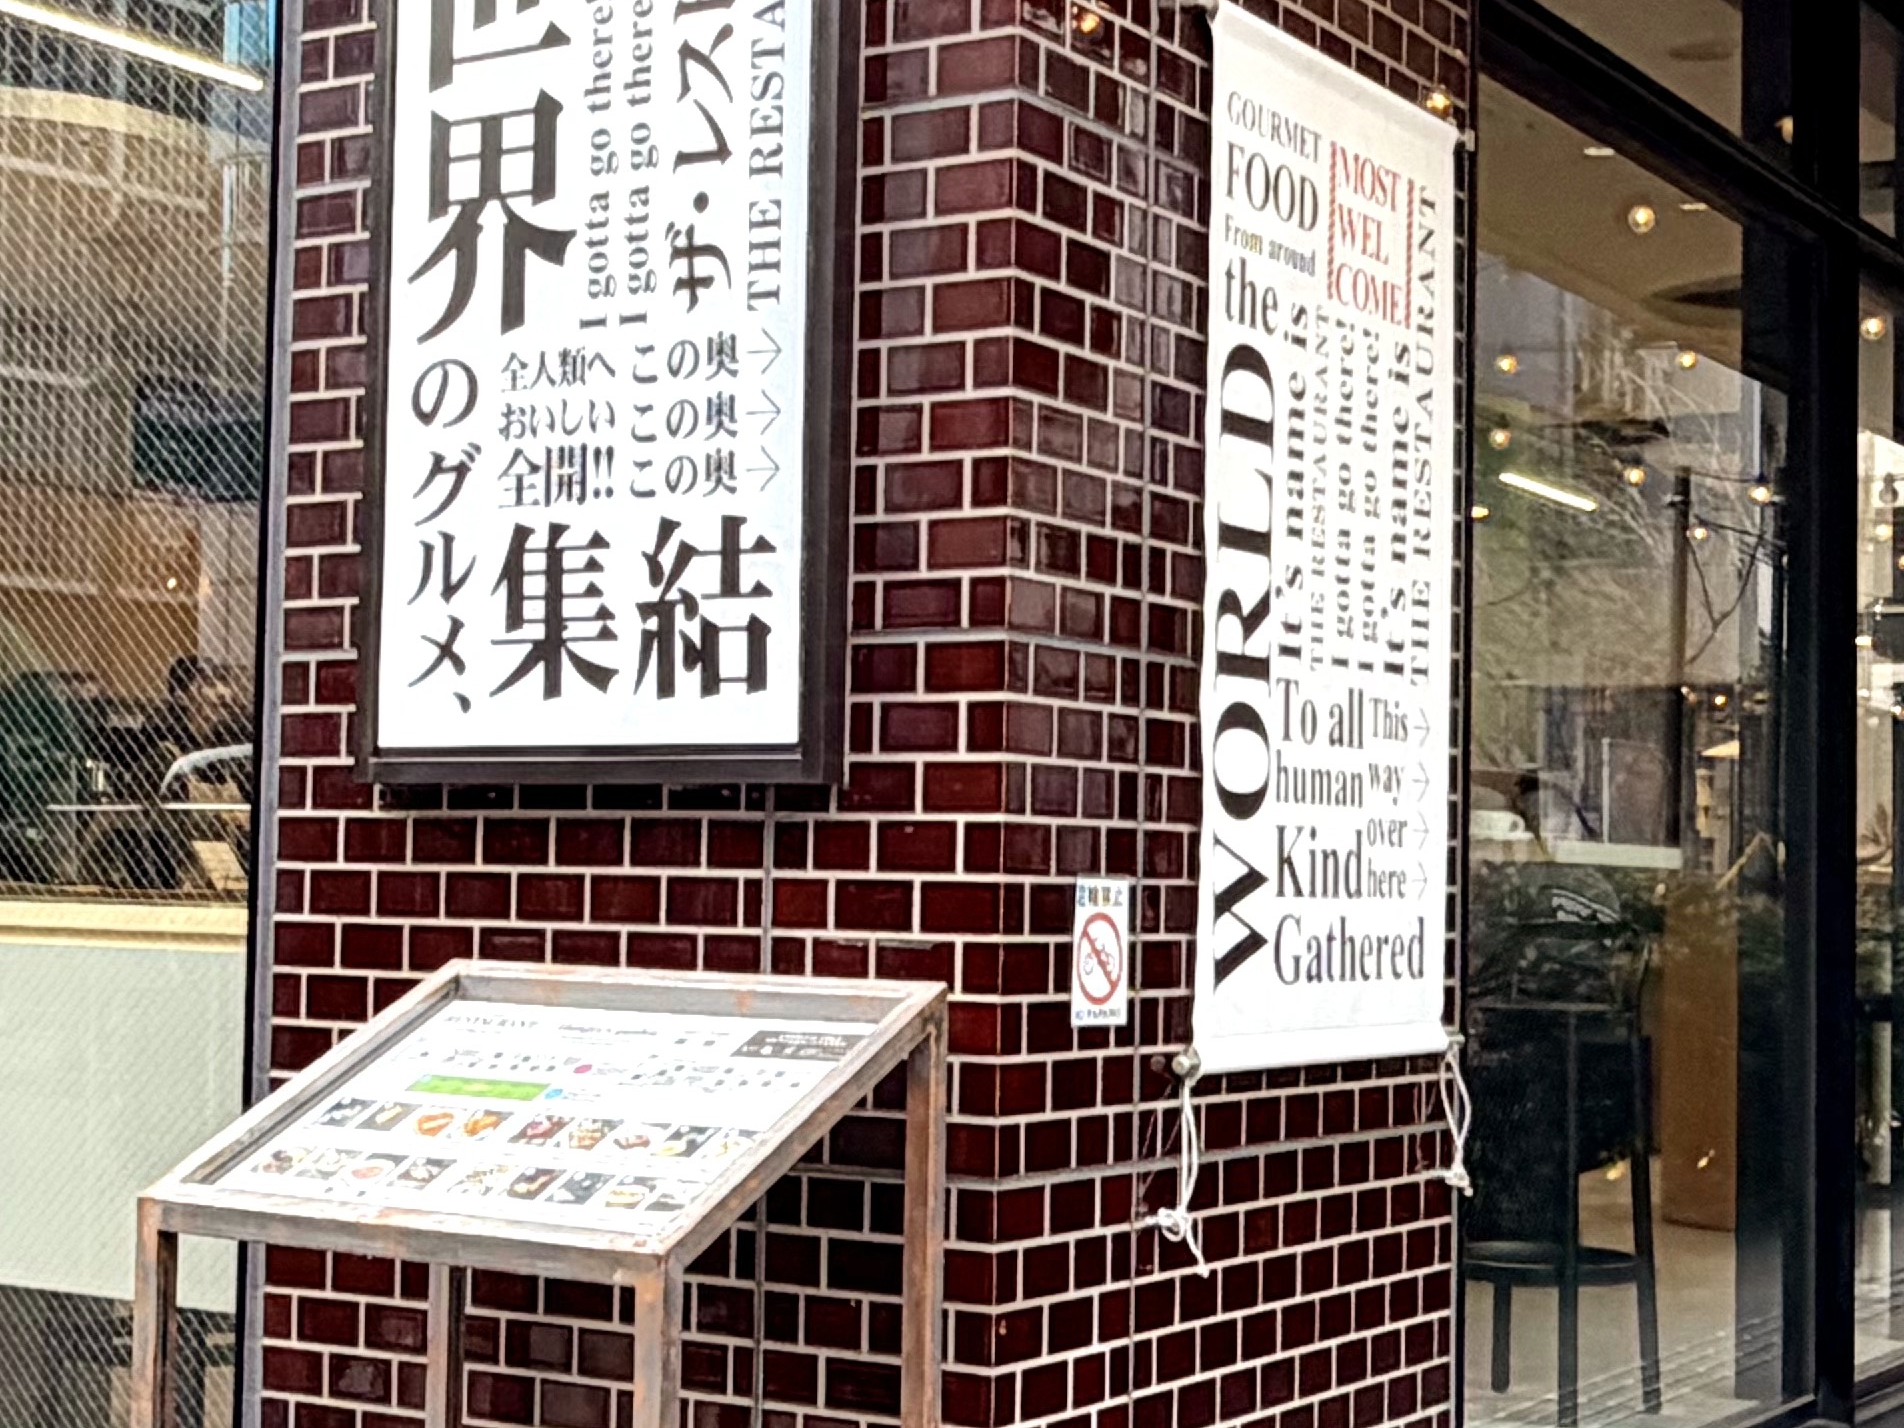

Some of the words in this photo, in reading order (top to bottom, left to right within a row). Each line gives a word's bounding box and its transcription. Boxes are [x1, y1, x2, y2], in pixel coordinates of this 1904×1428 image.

[589, 128, 619, 176] go
[630, 122, 659, 169] go
[1227, 91, 1322, 163] GOURMET
[1227, 141, 1319, 232] FOOD
[1338, 146, 1402, 213] MOST
[584, 190, 617, 299] gotta
[624, 185, 657, 294] gotta
[747, 199, 782, 311] THE
[1225, 213, 1263, 255] From
[1268, 239, 1316, 277] around
[1338, 203, 1389, 265] WEL
[579, 312, 607, 329] I
[619, 311, 647, 325] I
[1224, 256, 1279, 336] the
[1336, 262, 1402, 325] COME
[631, 331, 739, 383] この奥
[1283, 302, 1308, 352] is
[500, 346, 616, 393] 全人類へ
[1334, 318, 1355, 446] there!
[1360, 327, 1380, 453] there!
[1388, 341, 1411, 389] is
[1412, 185, 1436, 561] RESTAURANT
[498, 399, 616, 441] おいしい
[630, 391, 738, 443] この奥
[1311, 304, 1330, 577] RESTAURANT
[629, 448, 738, 498] この奥
[1285, 371, 1306, 541] name
[1338, 462, 1356, 514] go
[1391, 406, 1410, 564] name
[1364, 470, 1381, 519] go
[489, 514, 778, 700] 集結
[1335, 529, 1354, 639] gotta
[1361, 535, 1379, 643] gotta
[1310, 591, 1325, 672] THE
[1331, 655, 1349, 669] I
[1411, 579, 1430, 686] THE
[1213, 344, 1275, 996] WORLD
[1358, 659, 1374, 673] I
[1276, 677, 1318, 745] To
[1328, 687, 1364, 749] all
[1368, 696, 1409, 743] This
[1275, 749, 1363, 809] human
[1368, 761, 1404, 806] way
[1275, 825, 1363, 900] Kind
[1367, 817, 1408, 848] over
[1367, 856, 1407, 899] here
[1274, 913, 1425, 986] Gathered
